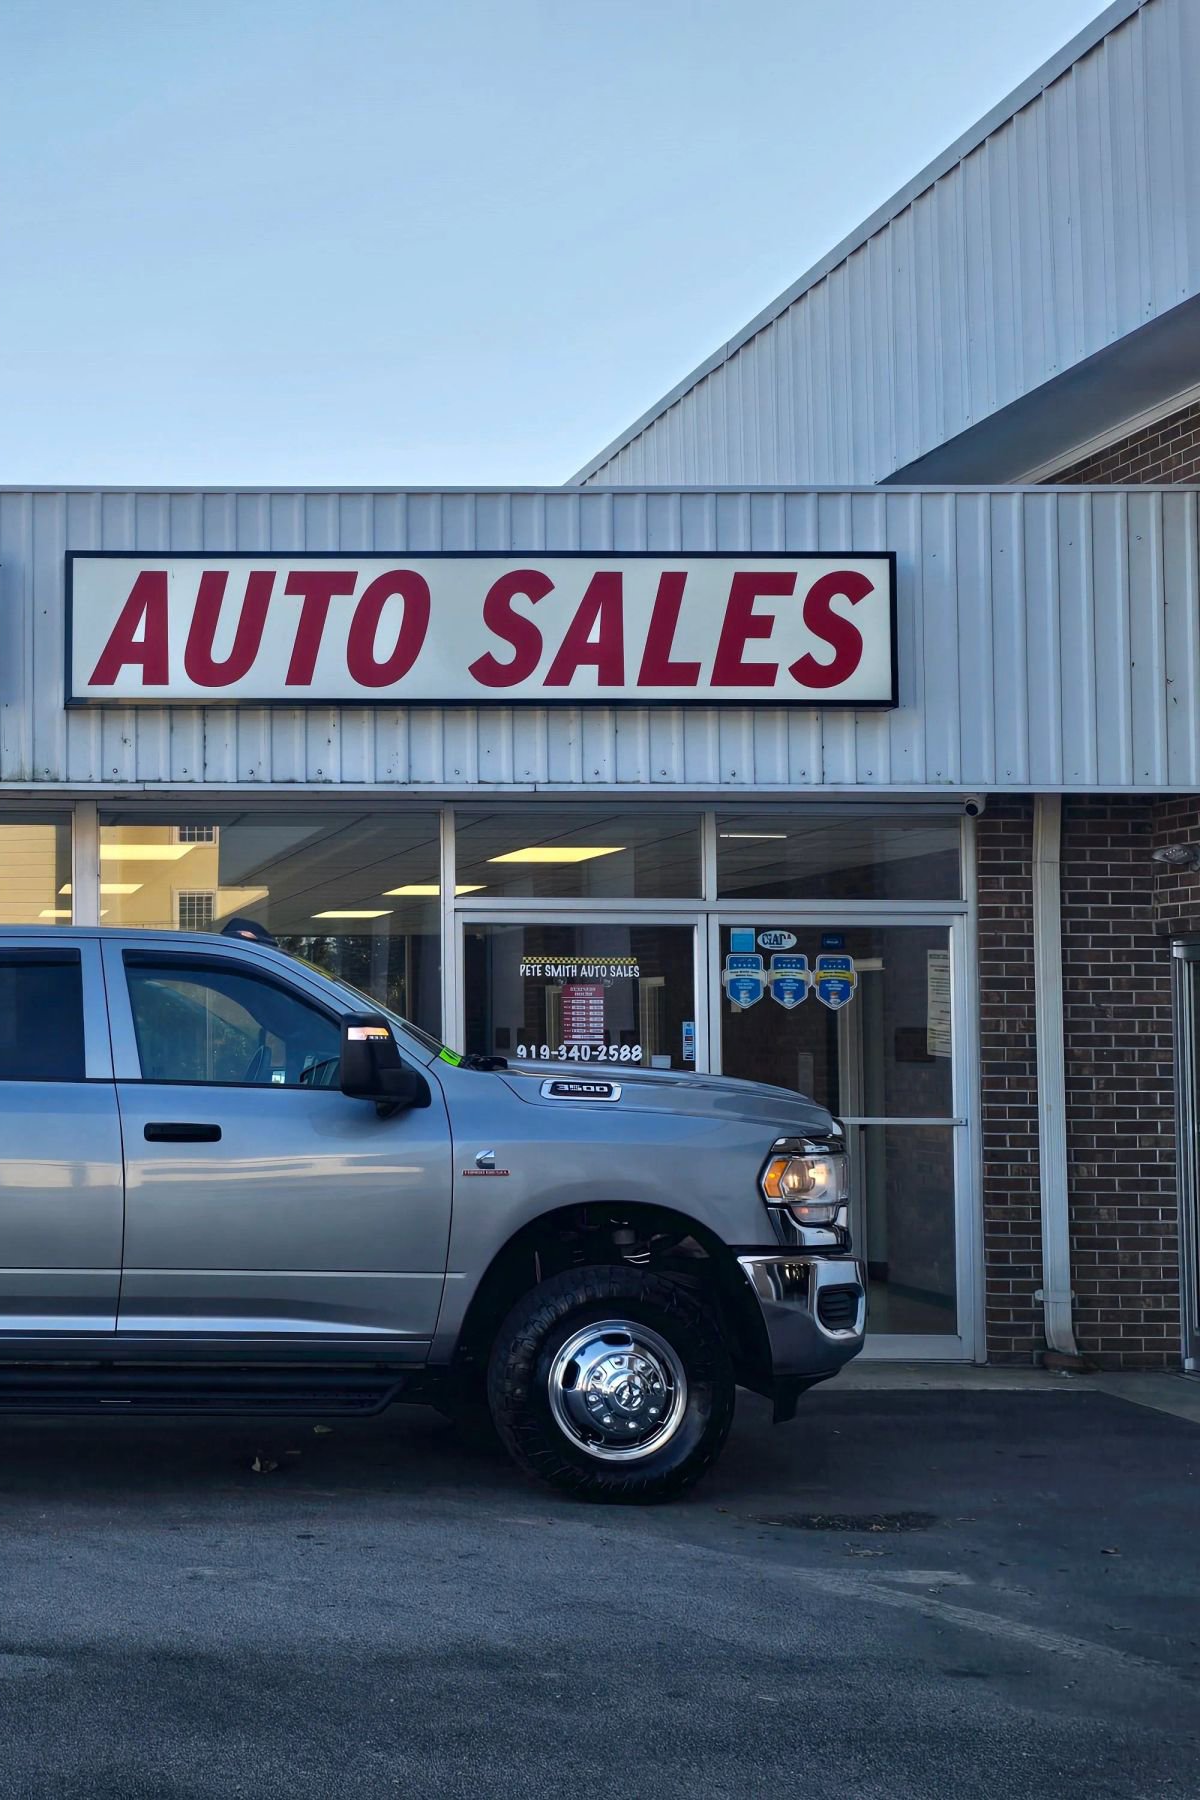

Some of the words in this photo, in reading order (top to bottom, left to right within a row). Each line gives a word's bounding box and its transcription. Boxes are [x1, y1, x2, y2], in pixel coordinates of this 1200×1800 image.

[88, 570, 431, 688] AUTO
[468, 569, 875, 689] SALES
[519, 964, 542, 977] PETE
[544, 964, 577, 978] SMITH
[580, 964, 607, 978] AUTO
[609, 965, 640, 978] SALES
[516, 1044, 643, 1062] 919-340-2588
